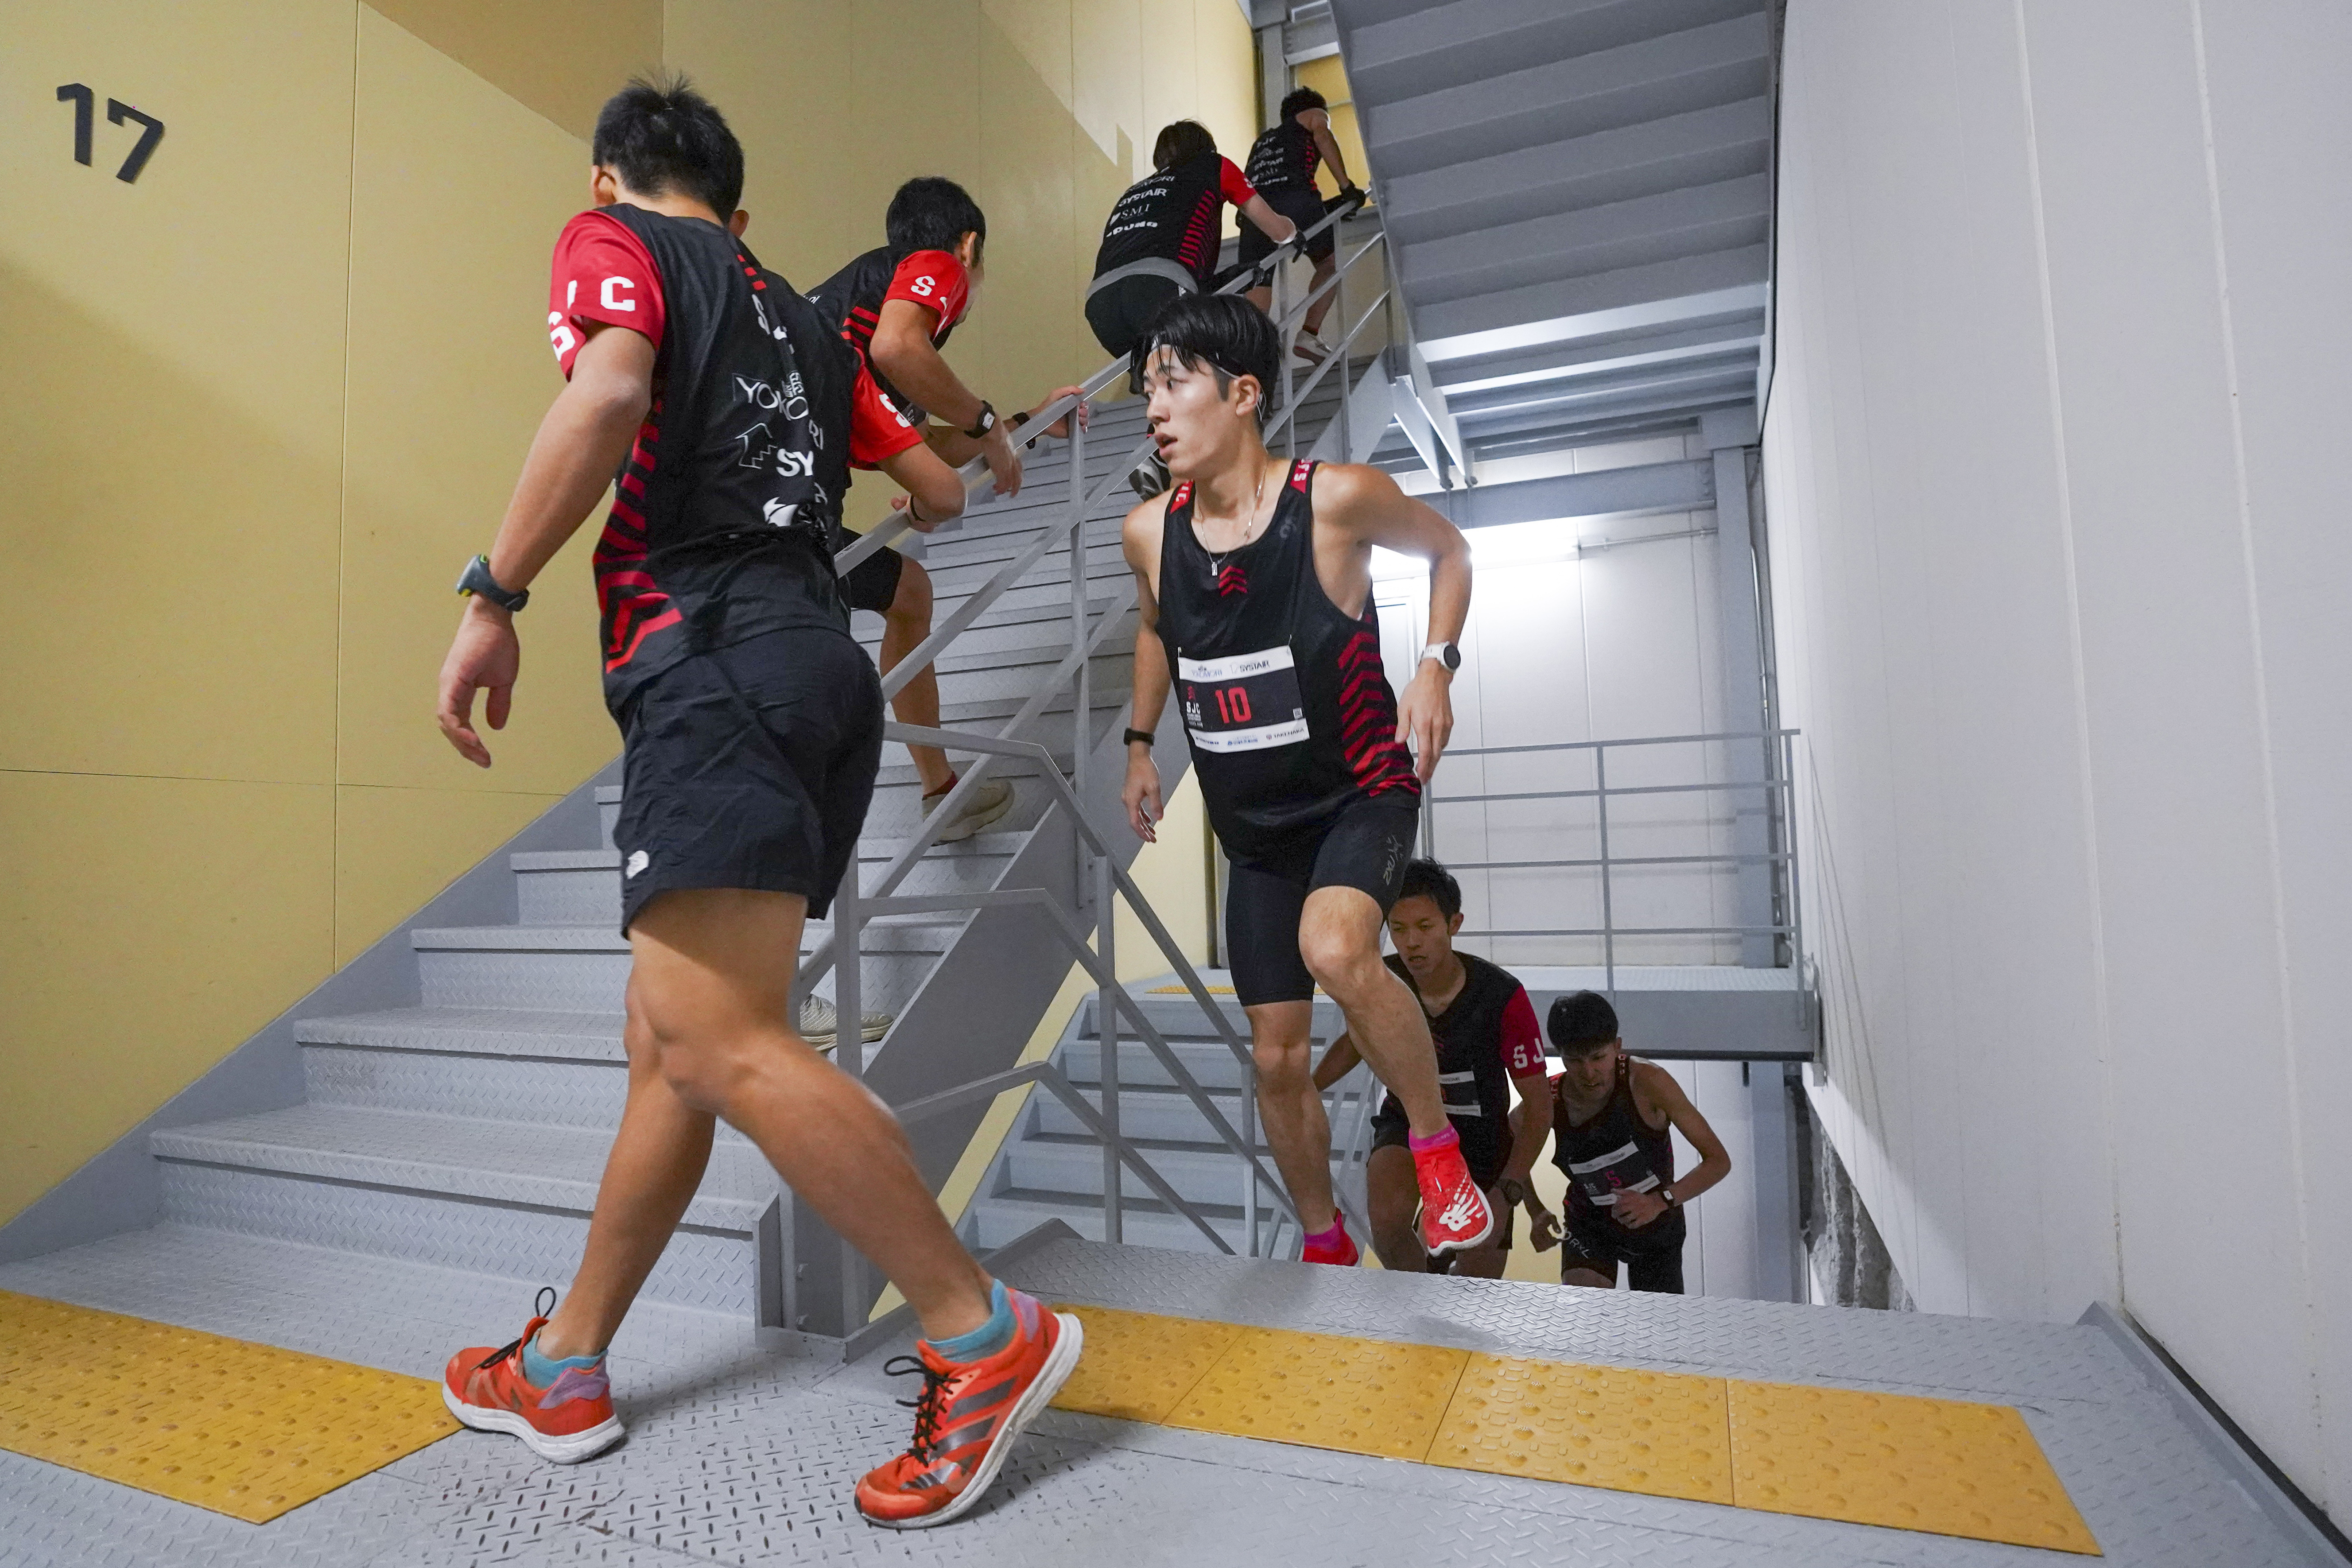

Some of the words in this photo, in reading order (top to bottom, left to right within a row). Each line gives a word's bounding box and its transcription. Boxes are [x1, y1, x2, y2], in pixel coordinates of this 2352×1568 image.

[56, 83, 164, 184] 17
[1215, 687, 1252, 724] 10
[1513, 1037, 1545, 1069] SJ
